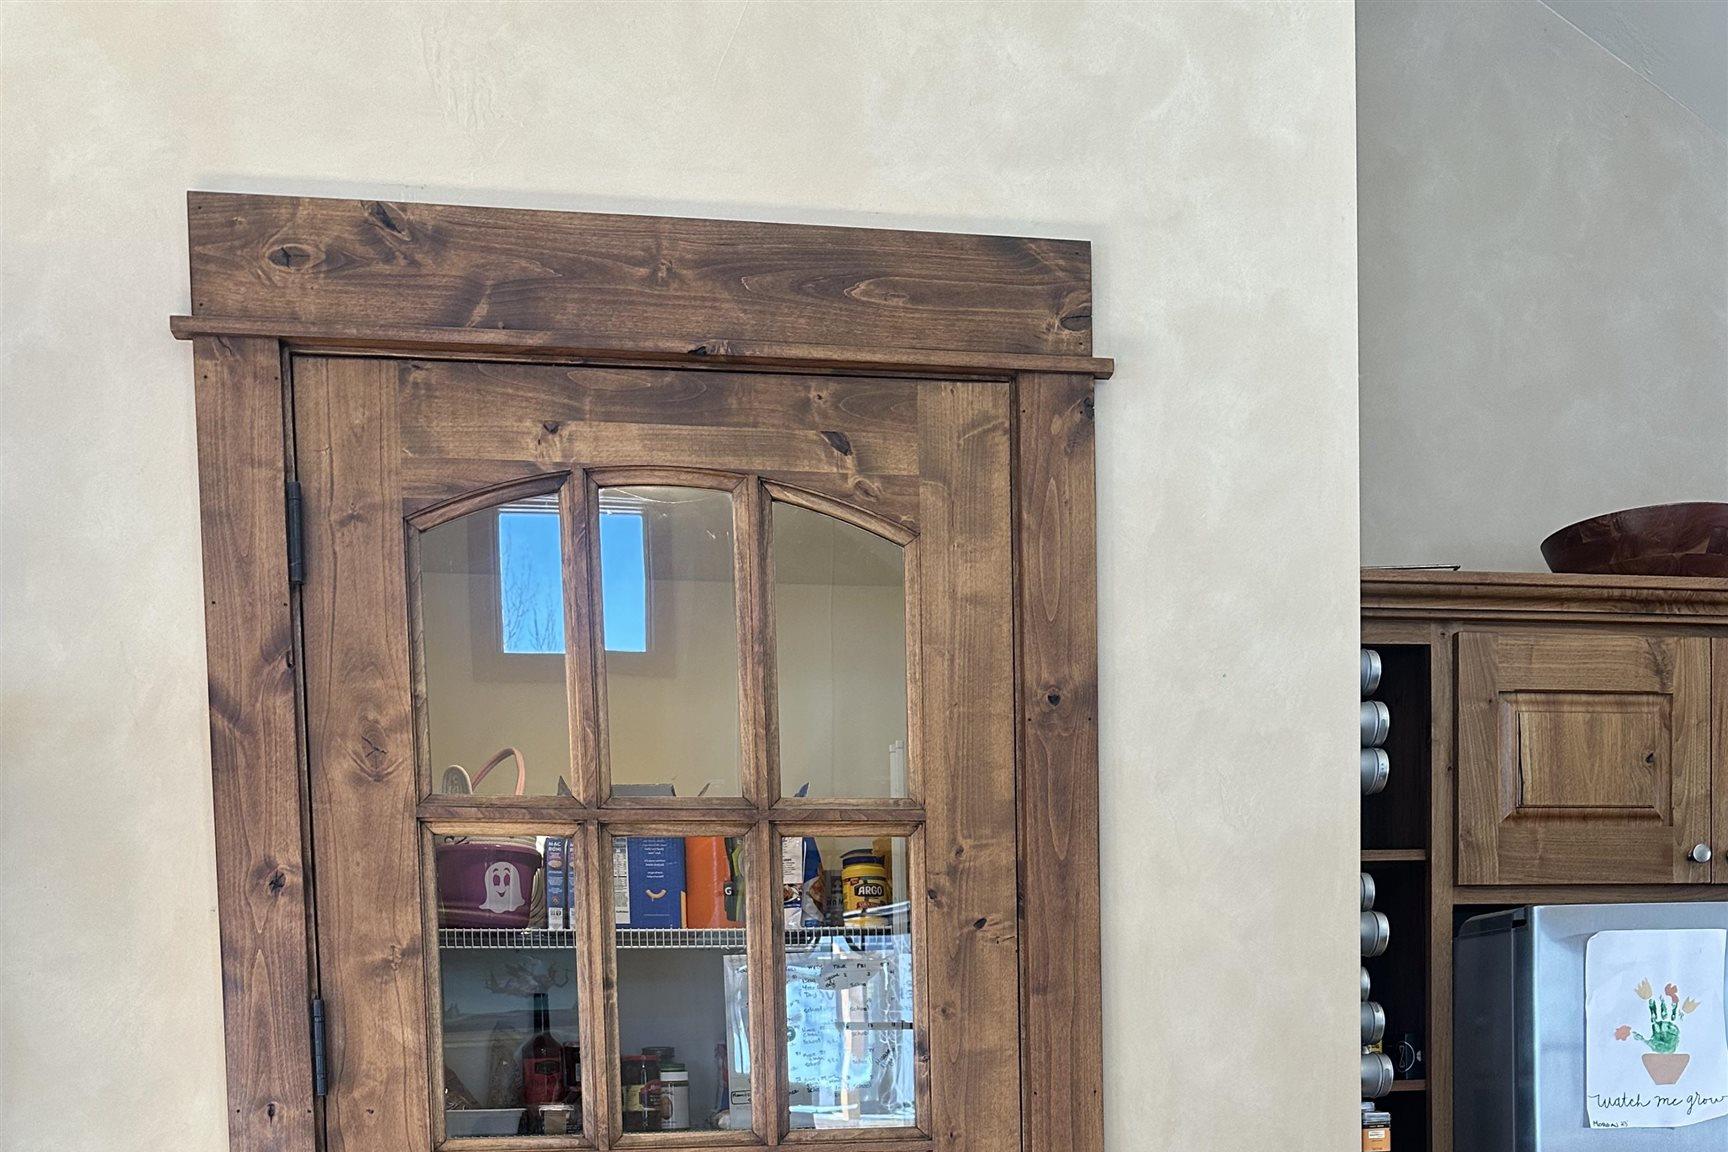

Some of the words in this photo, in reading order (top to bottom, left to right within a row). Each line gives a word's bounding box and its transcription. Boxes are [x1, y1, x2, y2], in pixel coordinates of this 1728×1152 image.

[858, 887, 883, 896] ARGO
[1654, 1095, 1683, 1107] me
[1687, 1091, 1728, 1115] grow
